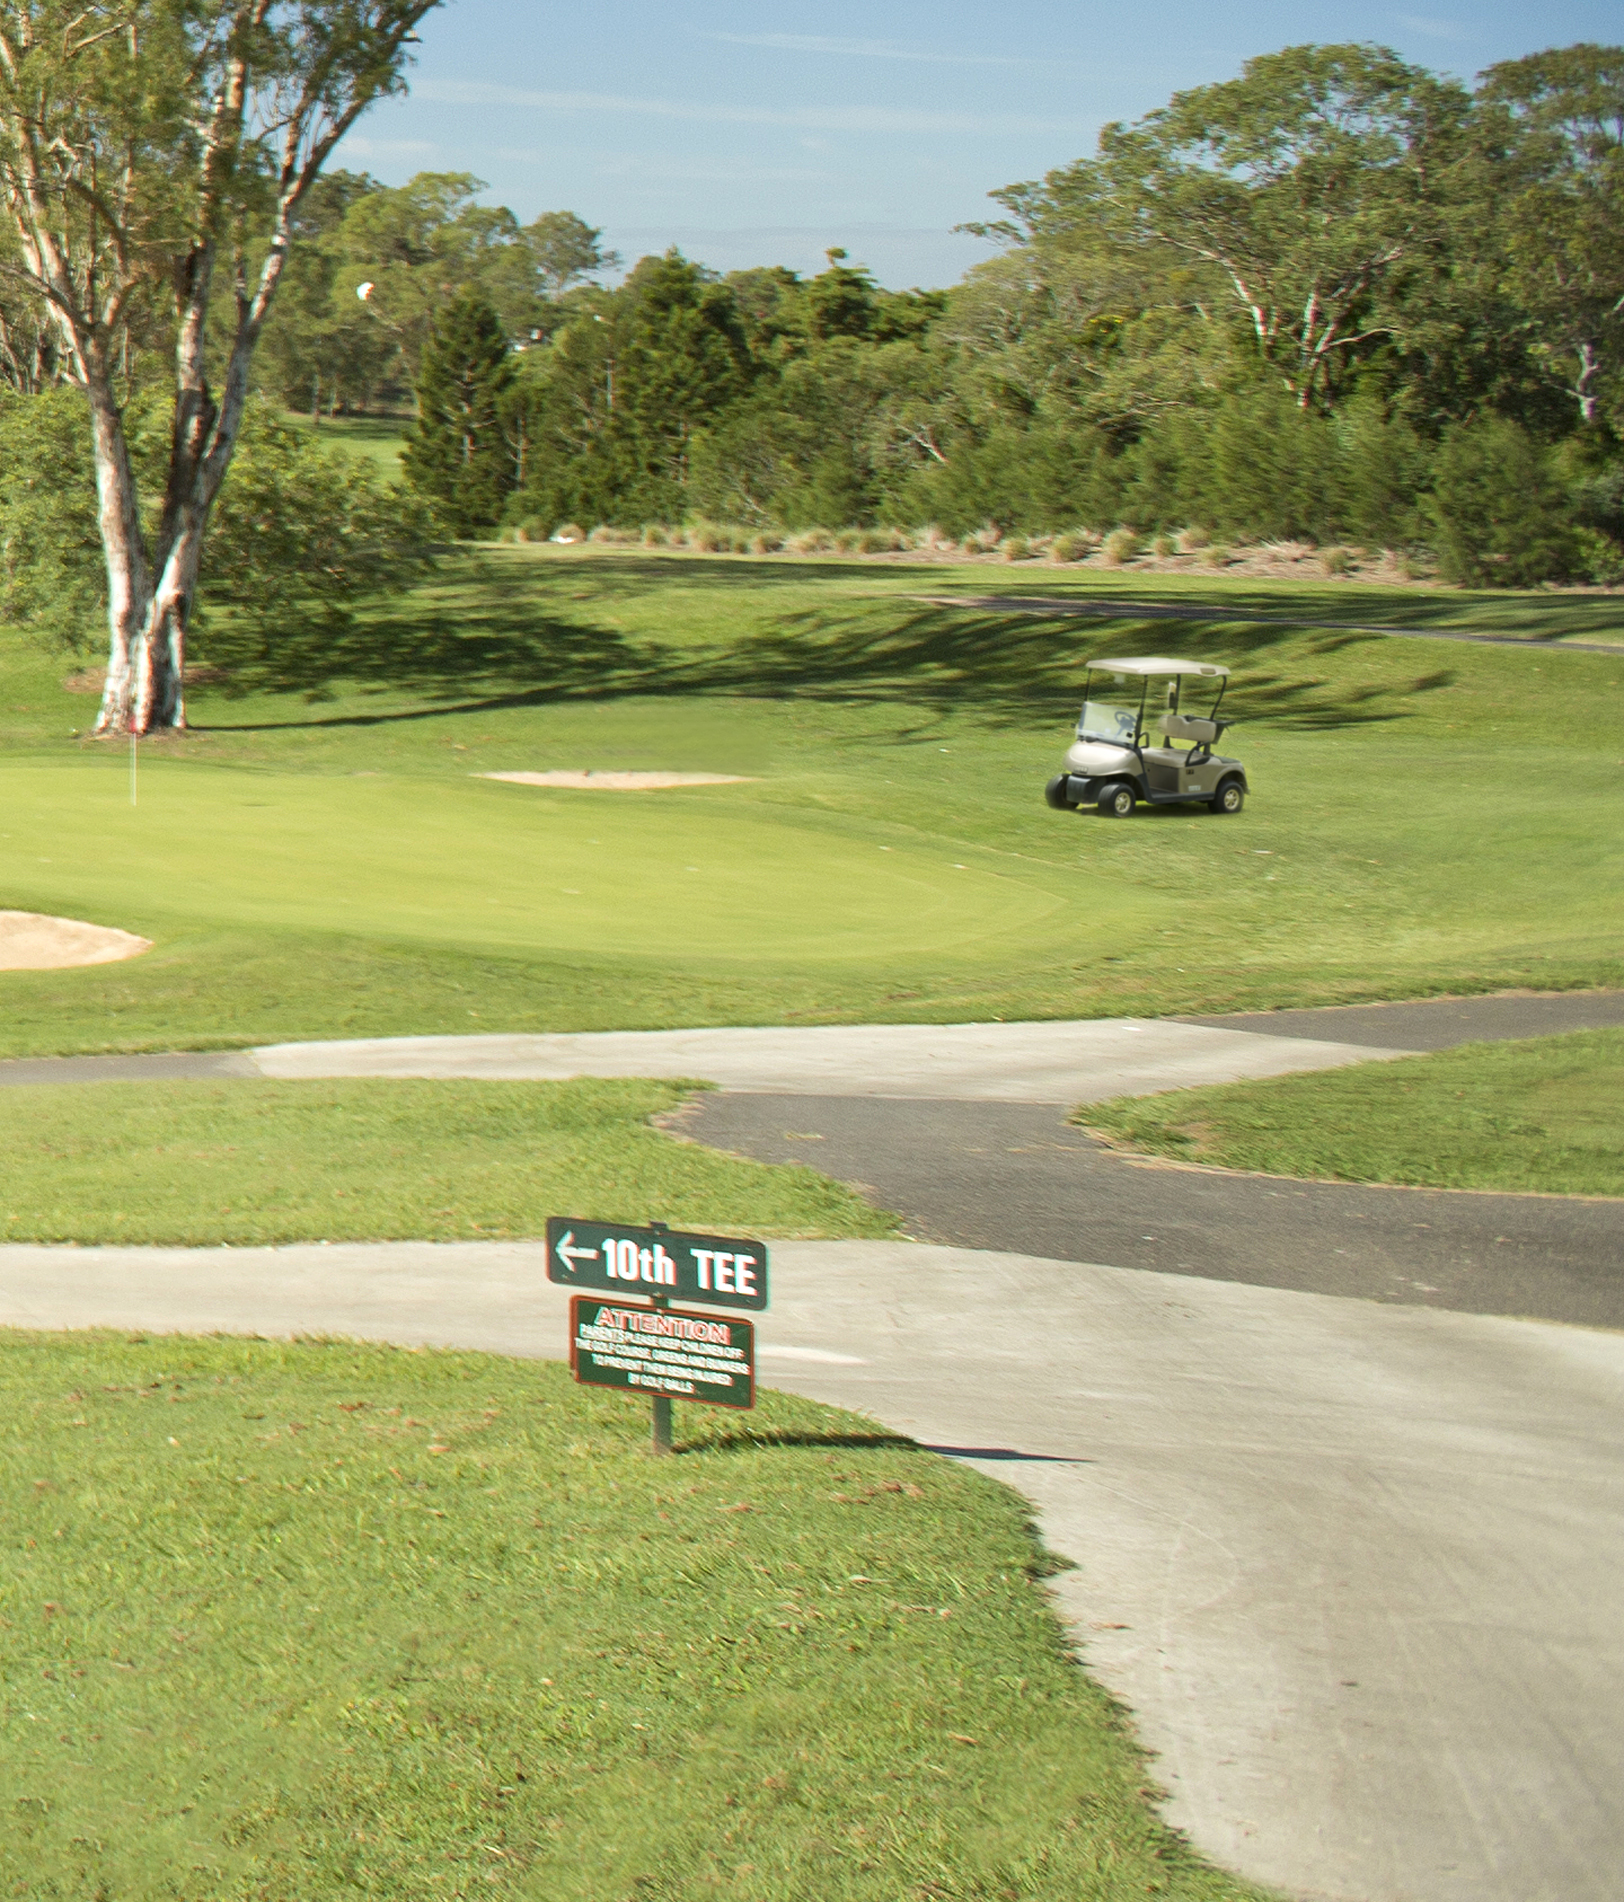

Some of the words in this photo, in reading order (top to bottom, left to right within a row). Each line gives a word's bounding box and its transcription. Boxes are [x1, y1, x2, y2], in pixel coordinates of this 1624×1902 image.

[602, 1238, 676, 1285] 10th
[690, 1248, 757, 1296] TEE
[594, 1306, 730, 1345] ATTENTION
[591, 1341, 615, 1354] GOLF
[688, 1355, 705, 1367] AND
[640, 1375, 663, 1388] GOLF
[663, 1378, 694, 1393] BALLS
